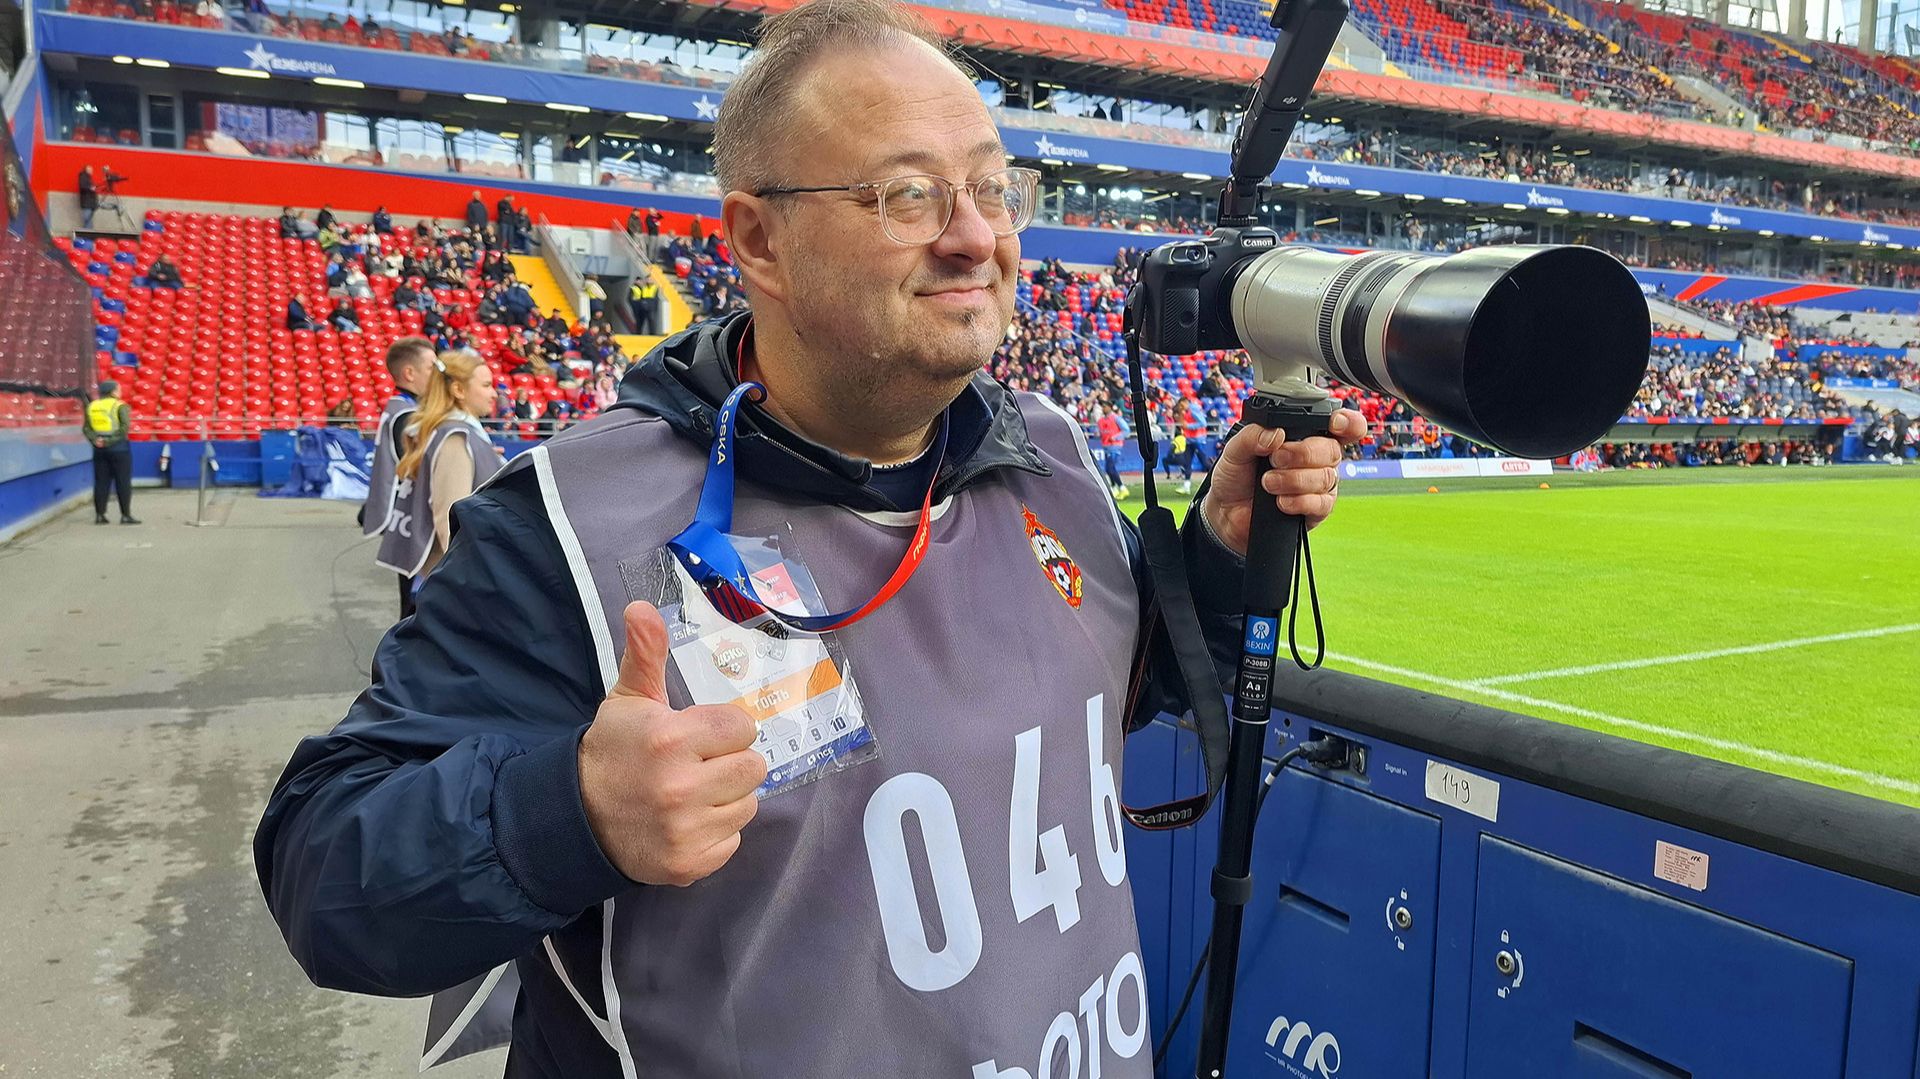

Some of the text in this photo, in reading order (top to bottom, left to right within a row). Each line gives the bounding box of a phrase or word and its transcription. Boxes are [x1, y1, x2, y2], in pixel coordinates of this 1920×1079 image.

[1243, 238, 1273, 247] Canon
[585, 256, 609, 275] 217
[1245, 639, 1270, 651] BEXIN
[1246, 681, 1261, 691] Aa
[766, 716, 847, 764] 7 8 9 10
[1442, 771, 1470, 804] 149
[1129, 807, 1193, 824] Canon
[863, 692, 1127, 992] 046
[971, 951, 1147, 1079] ОТО
